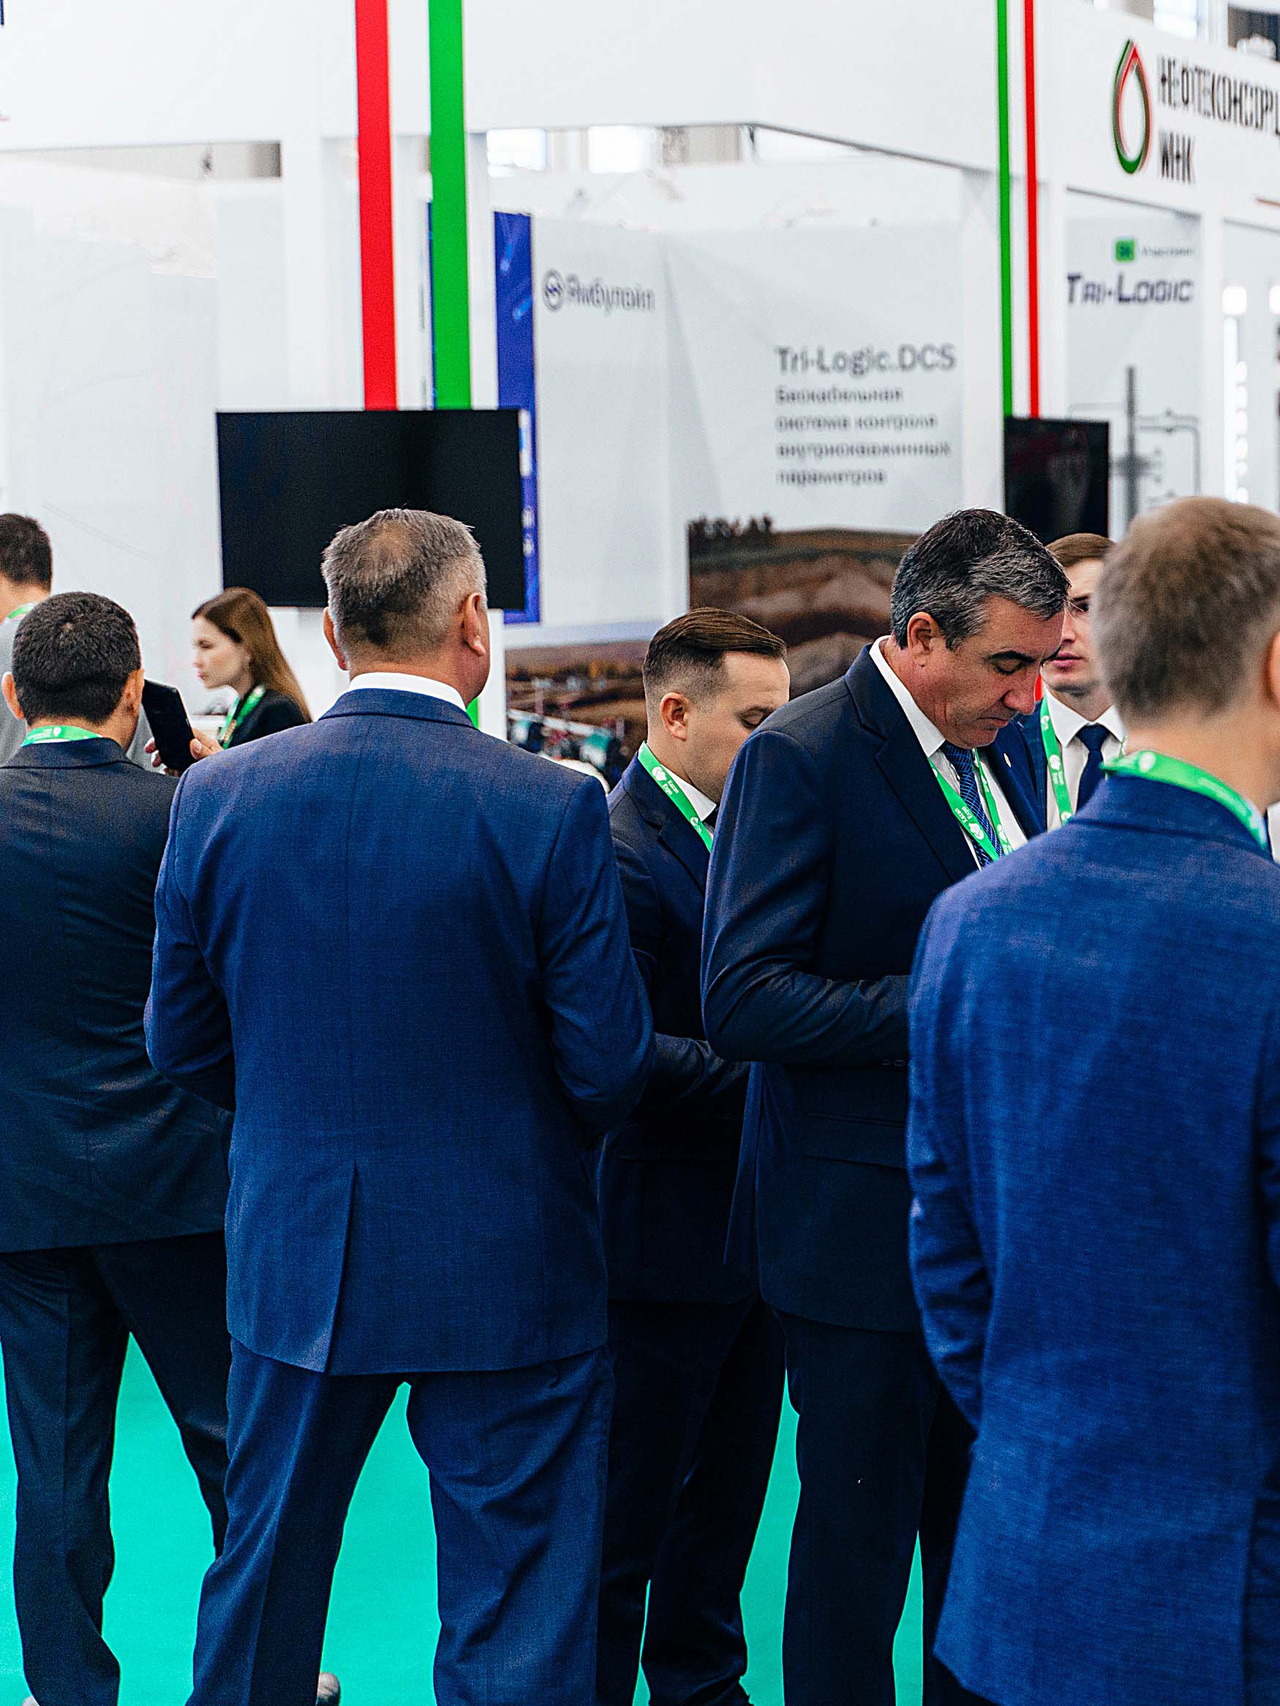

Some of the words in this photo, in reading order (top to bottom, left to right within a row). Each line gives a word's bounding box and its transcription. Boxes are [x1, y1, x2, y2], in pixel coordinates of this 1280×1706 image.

[662, 783, 672, 795] Expo
[667, 780, 679, 793] Kazan
[954, 807, 967, 823] Kazan
[962, 806, 972, 819] Expo
